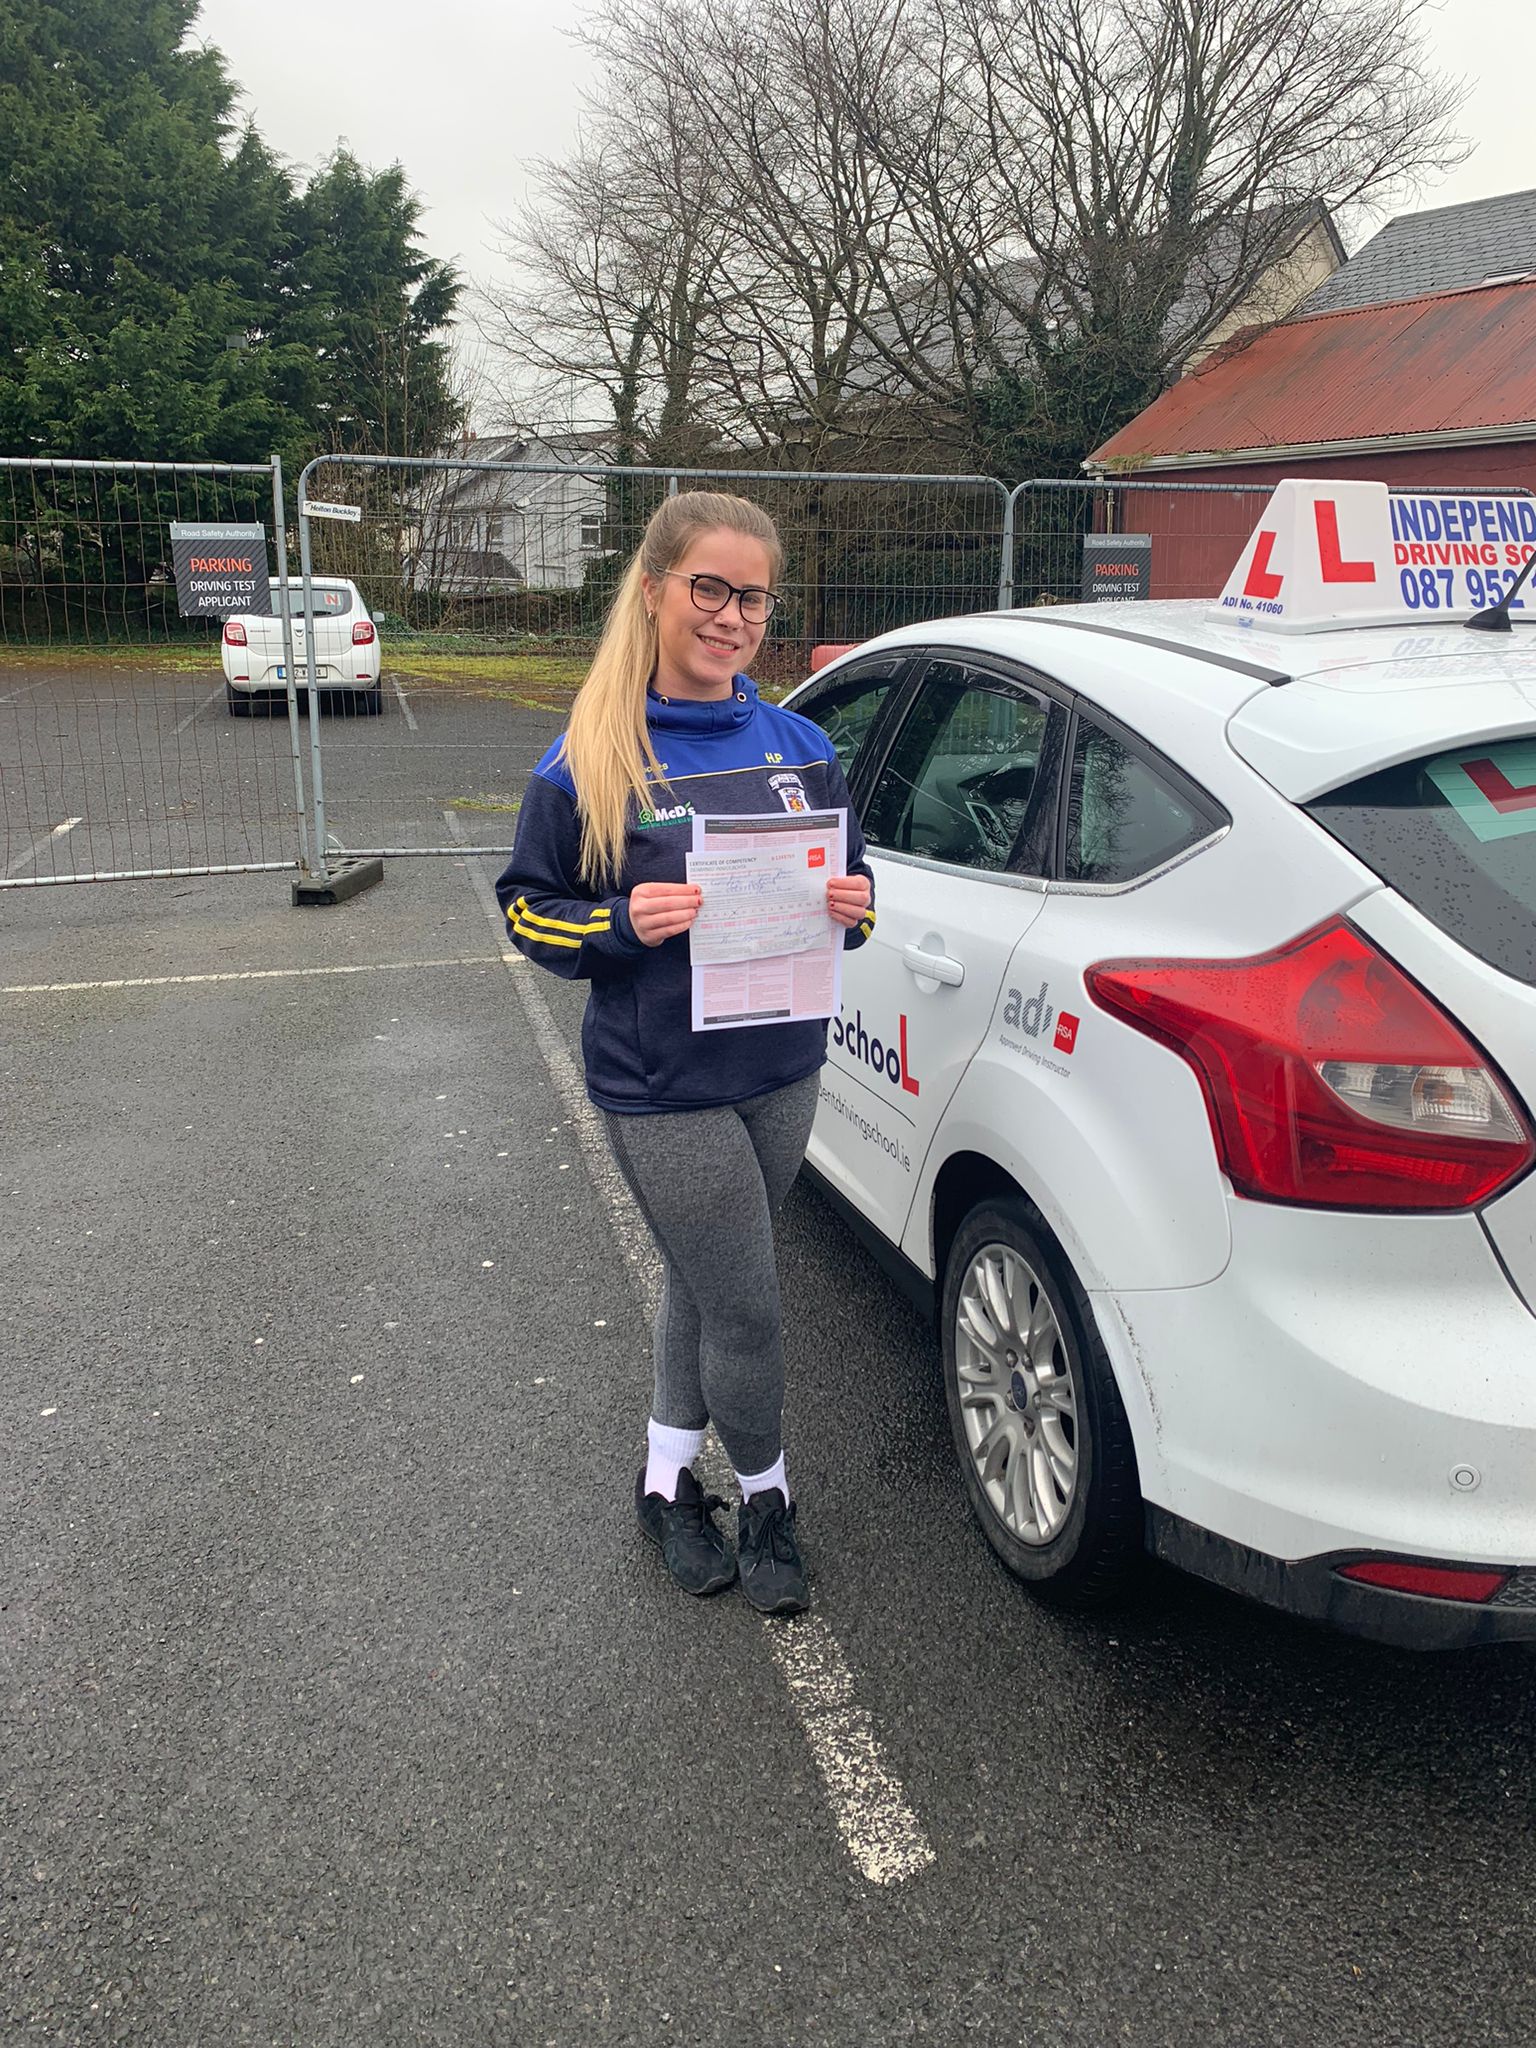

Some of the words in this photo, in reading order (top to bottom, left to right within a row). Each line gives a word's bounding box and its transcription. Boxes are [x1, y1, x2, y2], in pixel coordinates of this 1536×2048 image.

[332, 507, 356, 518] Buckley
[181, 529, 200, 537] Road
[202, 529, 224, 538] Safety
[225, 529, 256, 538] Authority
[1107, 539, 1122, 547] Safety
[1123, 539, 1145, 547] Authority
[1313, 500, 1376, 583] L
[1395, 543, 1498, 566] DRIVING
[190, 558, 252, 573] PARKING
[1095, 563, 1139, 576] PARKING
[1243, 531, 1284, 599] L
[190, 580, 231, 592] DRIVING
[233, 580, 256, 591] TEST
[1092, 583, 1122, 593] DRIVING
[1123, 583, 1140, 592] TEST
[1400, 568, 1454, 609] 087
[1466, 568, 1525, 609] 952
[198, 595, 252, 607] APPLICANT
[326, 593, 339, 604] N
[1222, 596, 1239, 608] ADI
[1240, 598, 1254, 610] No.
[1255, 600, 1284, 614] 41060
[726, 857, 757, 865] COMPETENCY
[1000, 1034, 1022, 1054] Approved
[1022, 1045, 1041, 1066] Driving
[1041, 1056, 1071, 1078] Instructor
